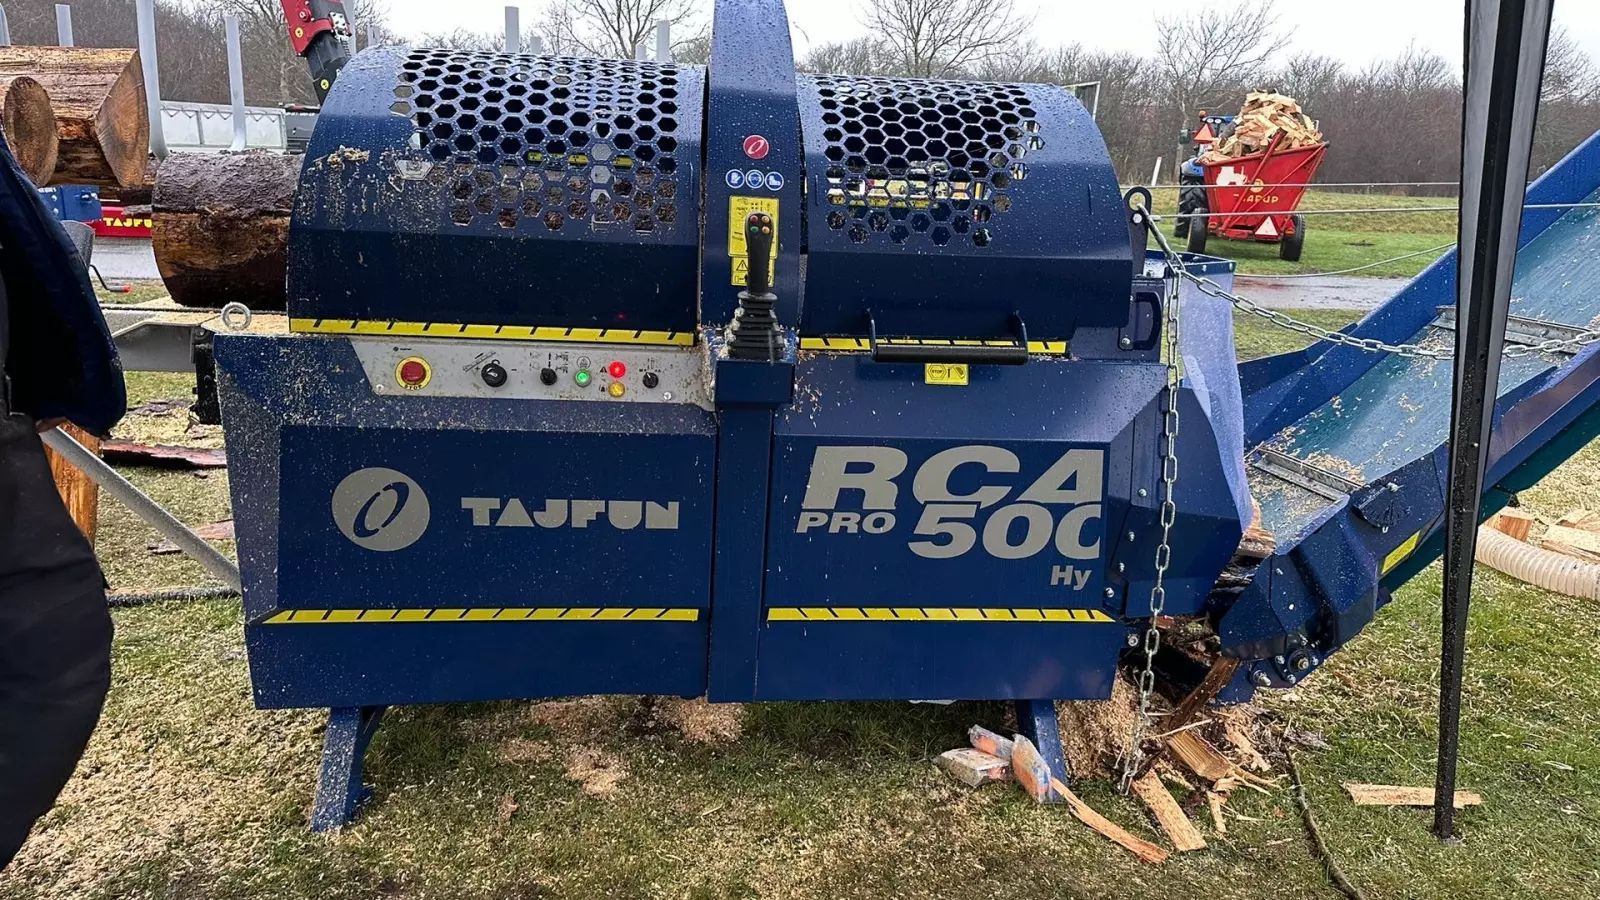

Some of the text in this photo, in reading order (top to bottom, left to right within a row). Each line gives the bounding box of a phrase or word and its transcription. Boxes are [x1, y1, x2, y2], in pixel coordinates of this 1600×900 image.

[103, 217, 153, 228] TAJFU
[801, 445, 1105, 509] RCA
[461, 497, 680, 530] TAJFUN
[796, 511, 897, 534] PRO
[1050, 565, 1092, 590] Hy
